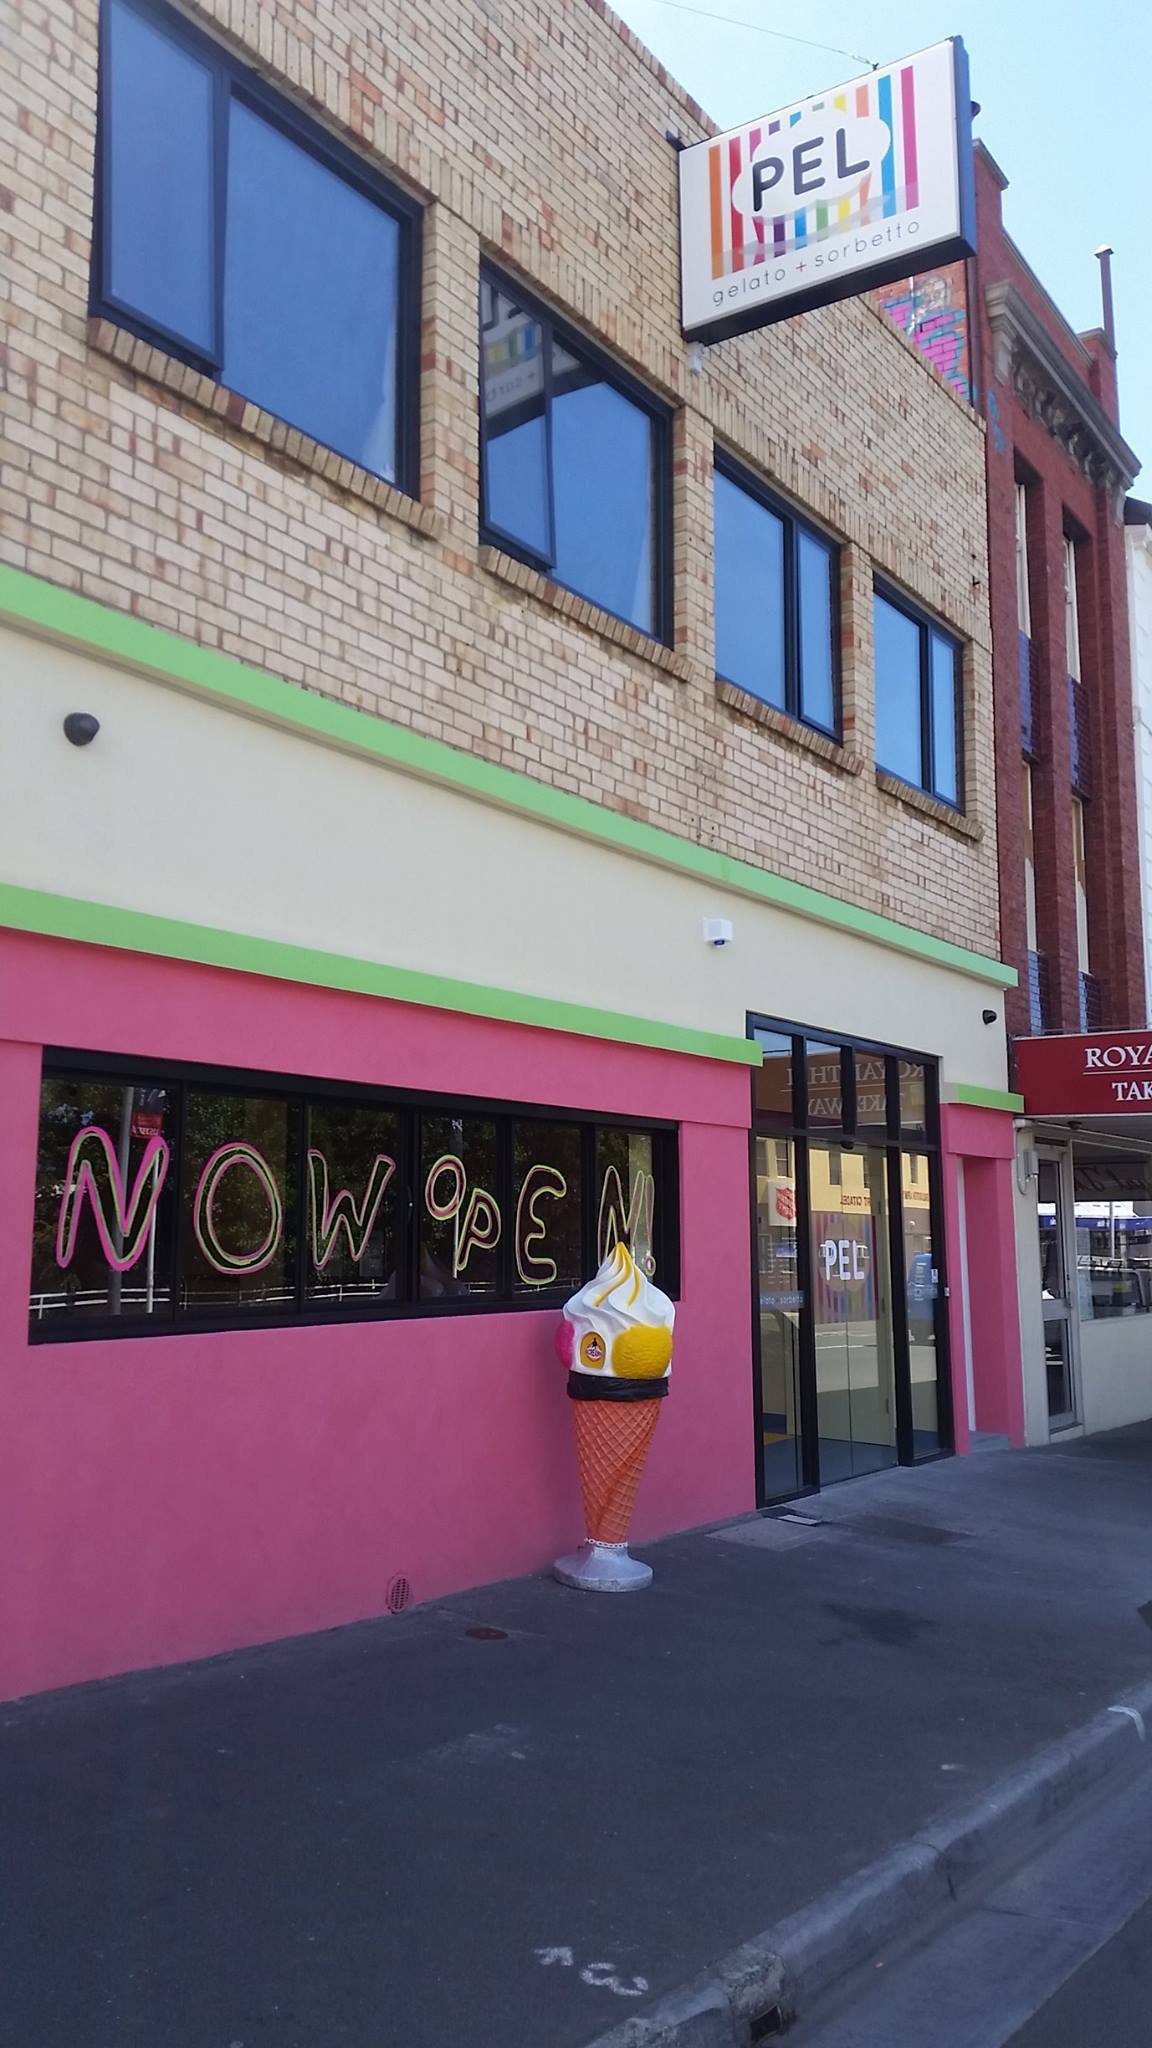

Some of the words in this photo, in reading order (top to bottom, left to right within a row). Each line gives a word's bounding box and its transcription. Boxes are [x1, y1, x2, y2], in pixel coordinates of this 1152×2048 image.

[752, 127, 870, 212] PEL
[712, 268, 786, 307] gelato
[814, 220, 920, 268] sorbetto
[55, 1126, 397, 1274] NOW
[824, 1239, 865, 1281] PEL
